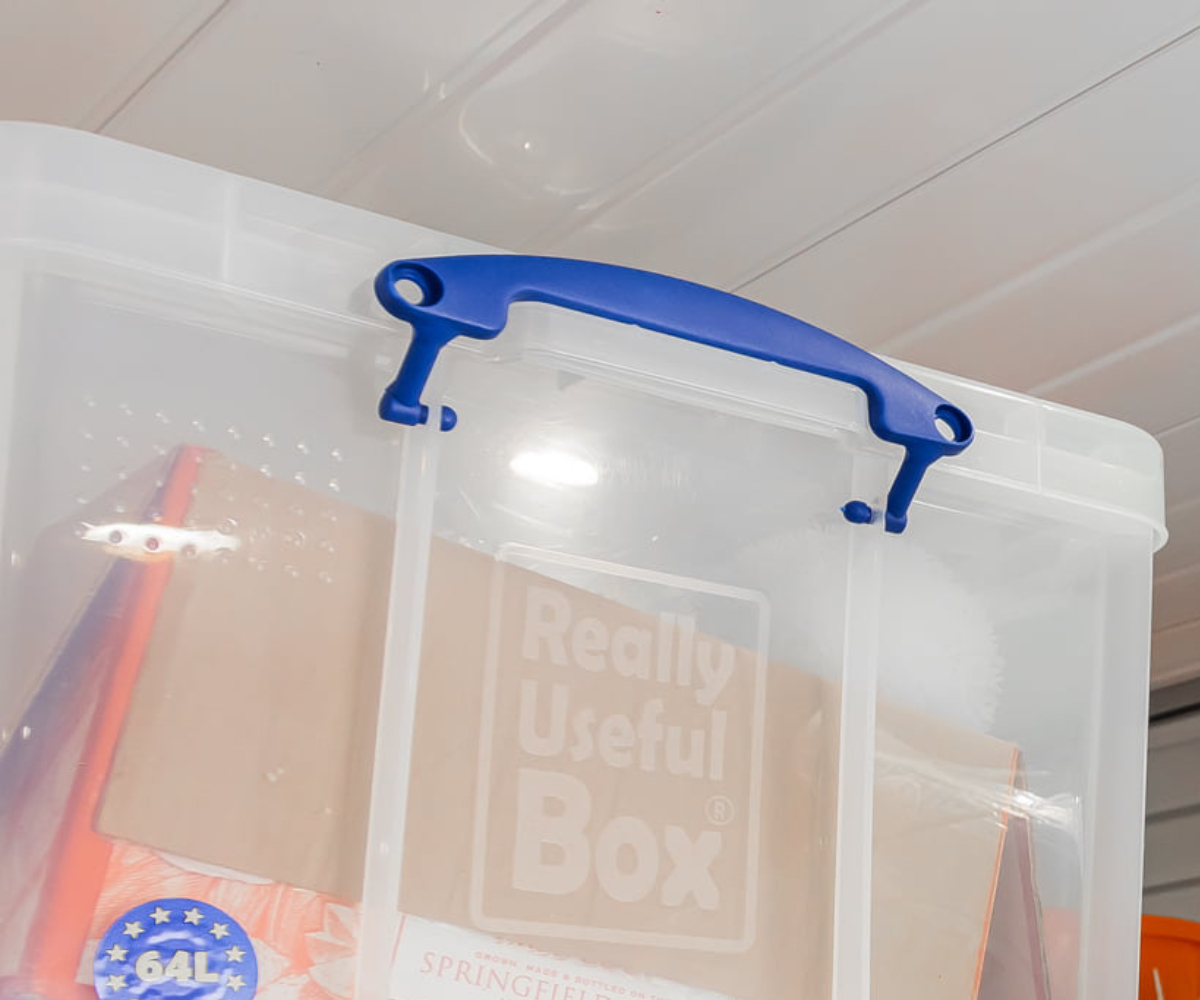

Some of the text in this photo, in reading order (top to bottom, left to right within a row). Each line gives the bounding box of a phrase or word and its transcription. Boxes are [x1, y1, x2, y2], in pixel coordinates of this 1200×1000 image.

[521, 586, 735, 706] Really
[518, 678, 728, 781] Useful
[135, 949, 220, 983] 64L
